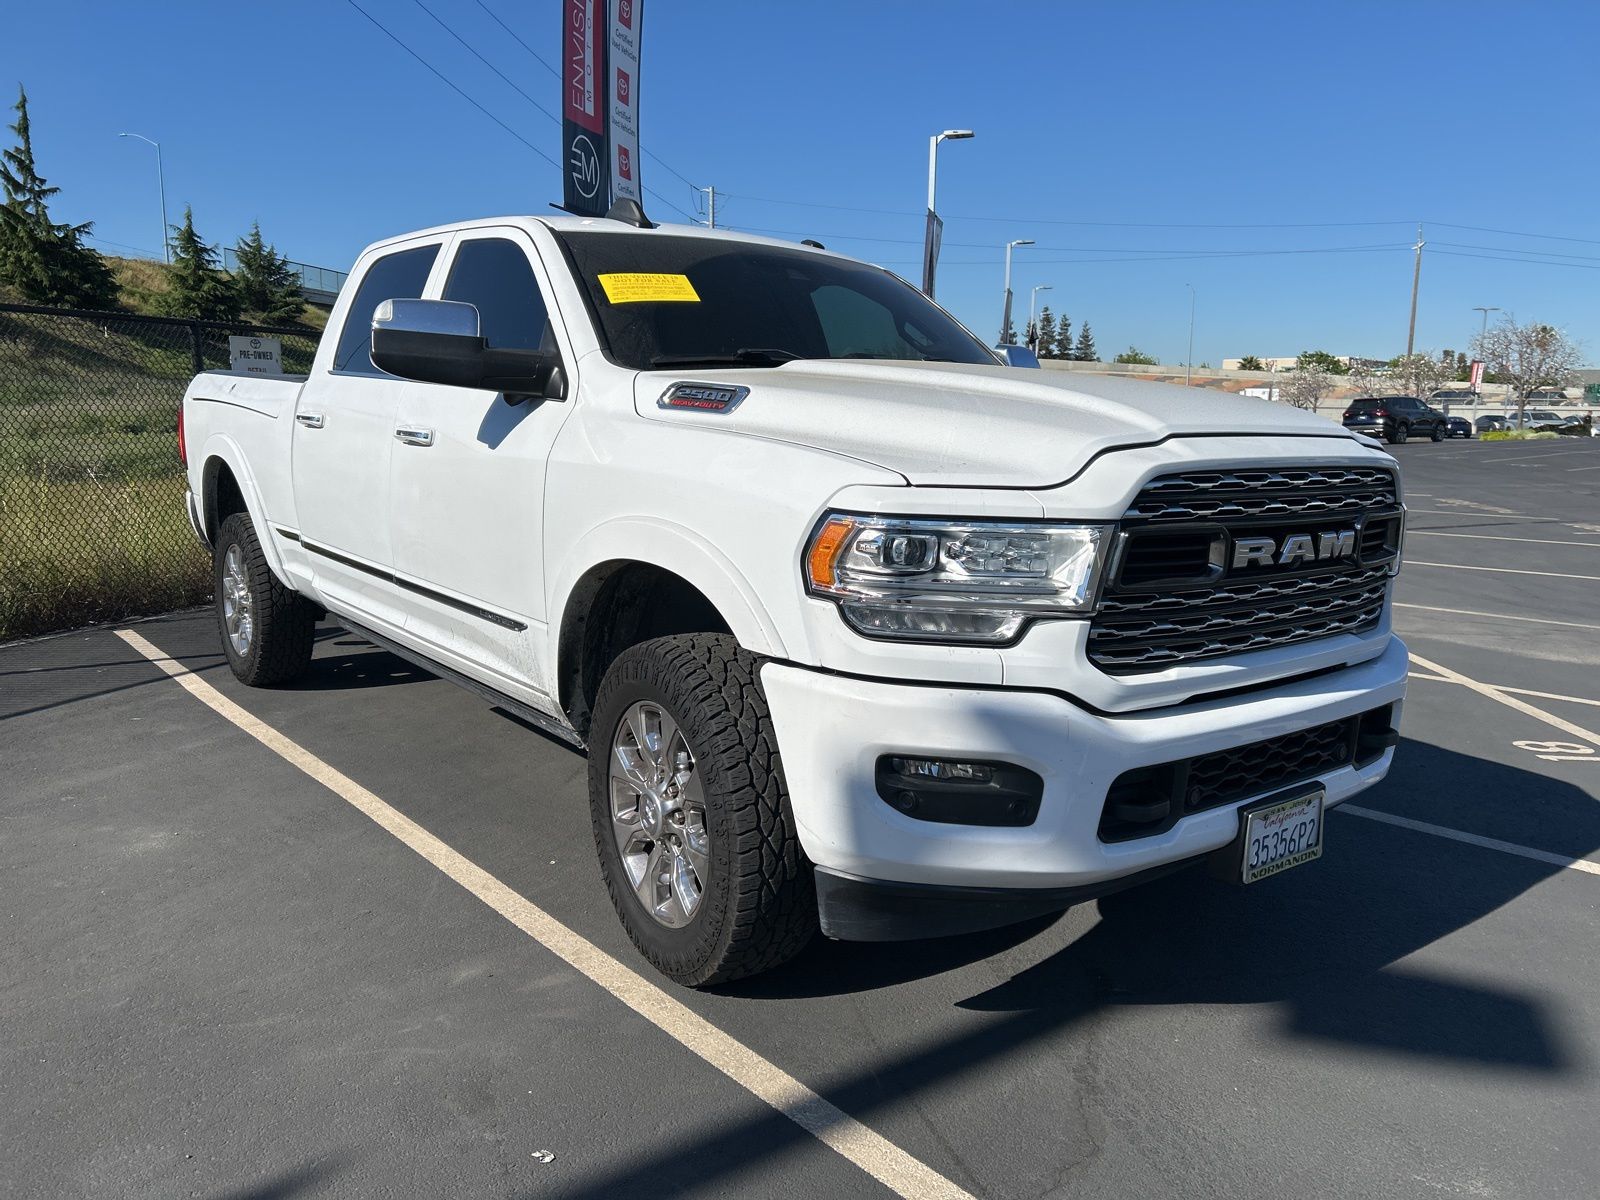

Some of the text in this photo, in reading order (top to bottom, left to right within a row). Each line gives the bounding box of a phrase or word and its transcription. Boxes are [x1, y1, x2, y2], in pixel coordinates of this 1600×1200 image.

[615, 28, 633, 47] Certified
[239, 350, 274, 361] PRE-OWNED
[677, 387, 732, 402] 2500
[1232, 529, 1355, 569] RAM
[1249, 819, 1316, 869] 35356P2
[1250, 849, 1319, 880] NORMANDIN
